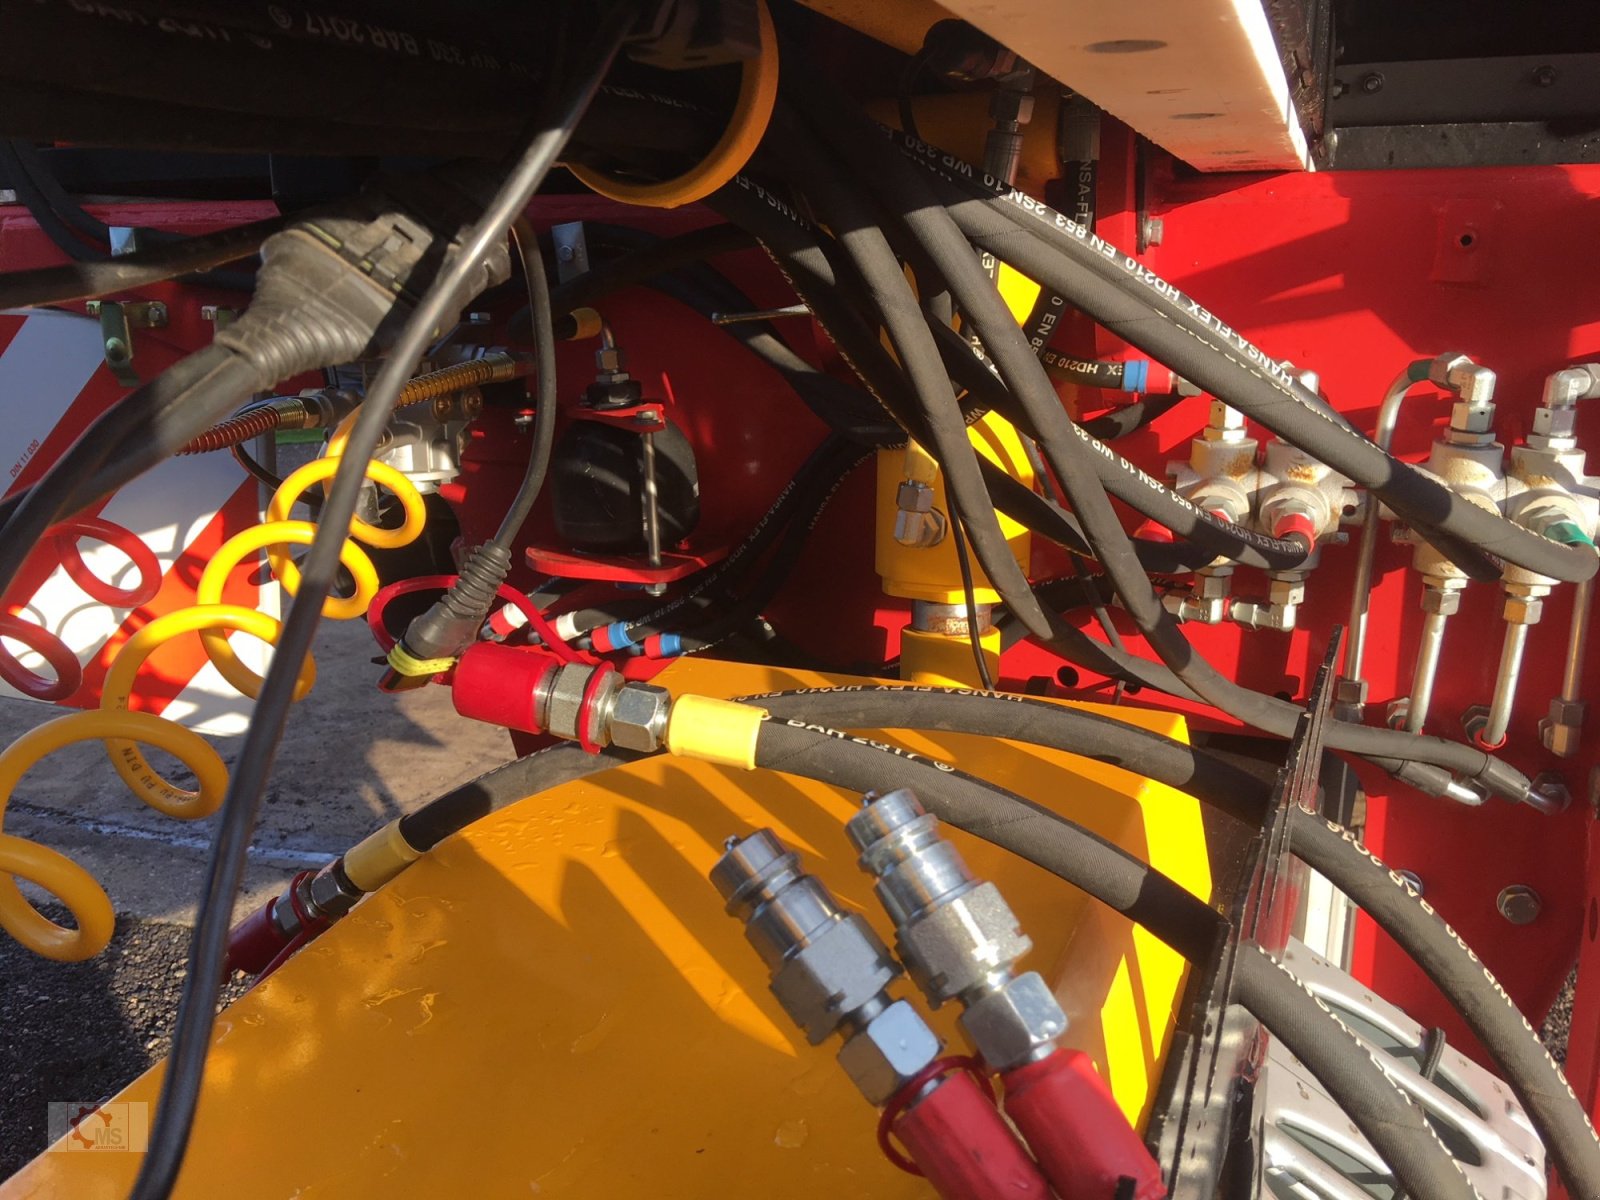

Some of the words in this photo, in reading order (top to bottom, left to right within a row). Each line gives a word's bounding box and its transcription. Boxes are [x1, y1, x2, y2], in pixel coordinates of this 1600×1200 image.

[366, 23, 420, 57] BAR
[941, 155, 973, 179] WP
[983, 173, 1004, 192] 10
[1008, 187, 1047, 217] 2SN
[1055, 212, 1087, 239] 853
[1090, 234, 1117, 259] EN
[1125, 256, 1180, 301] HD210
[1037, 313, 1057, 336] EN
[1187, 299, 1293, 387] HANSA-FLEX
[1057, 357, 1099, 375] HD210
